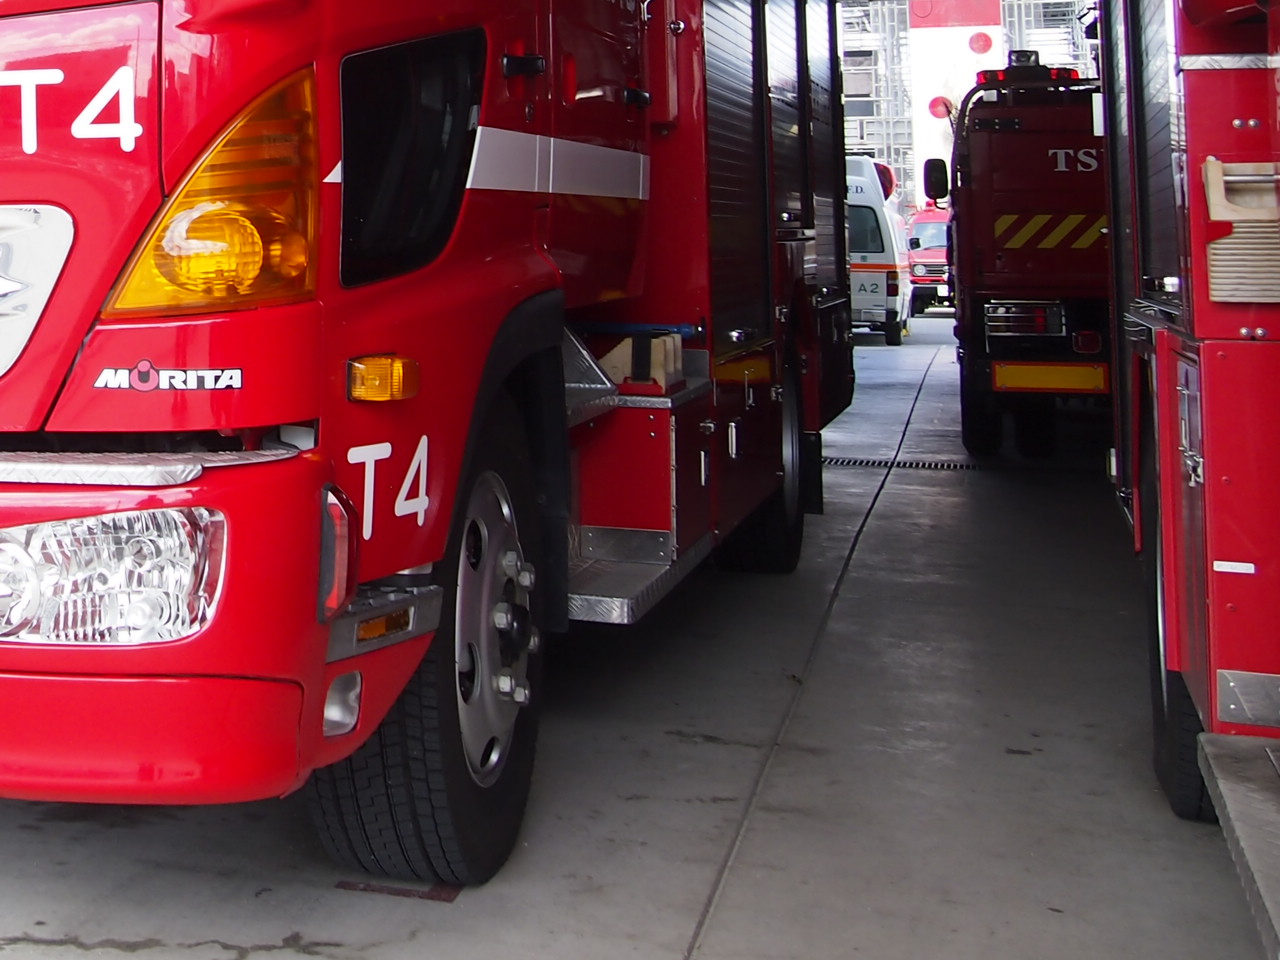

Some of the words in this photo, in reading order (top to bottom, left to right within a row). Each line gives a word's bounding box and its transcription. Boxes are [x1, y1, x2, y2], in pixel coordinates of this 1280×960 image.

[1048, 148, 1104, 172] TS
[93, 359, 243, 392] MORITA
[347, 434, 429, 541] T4
